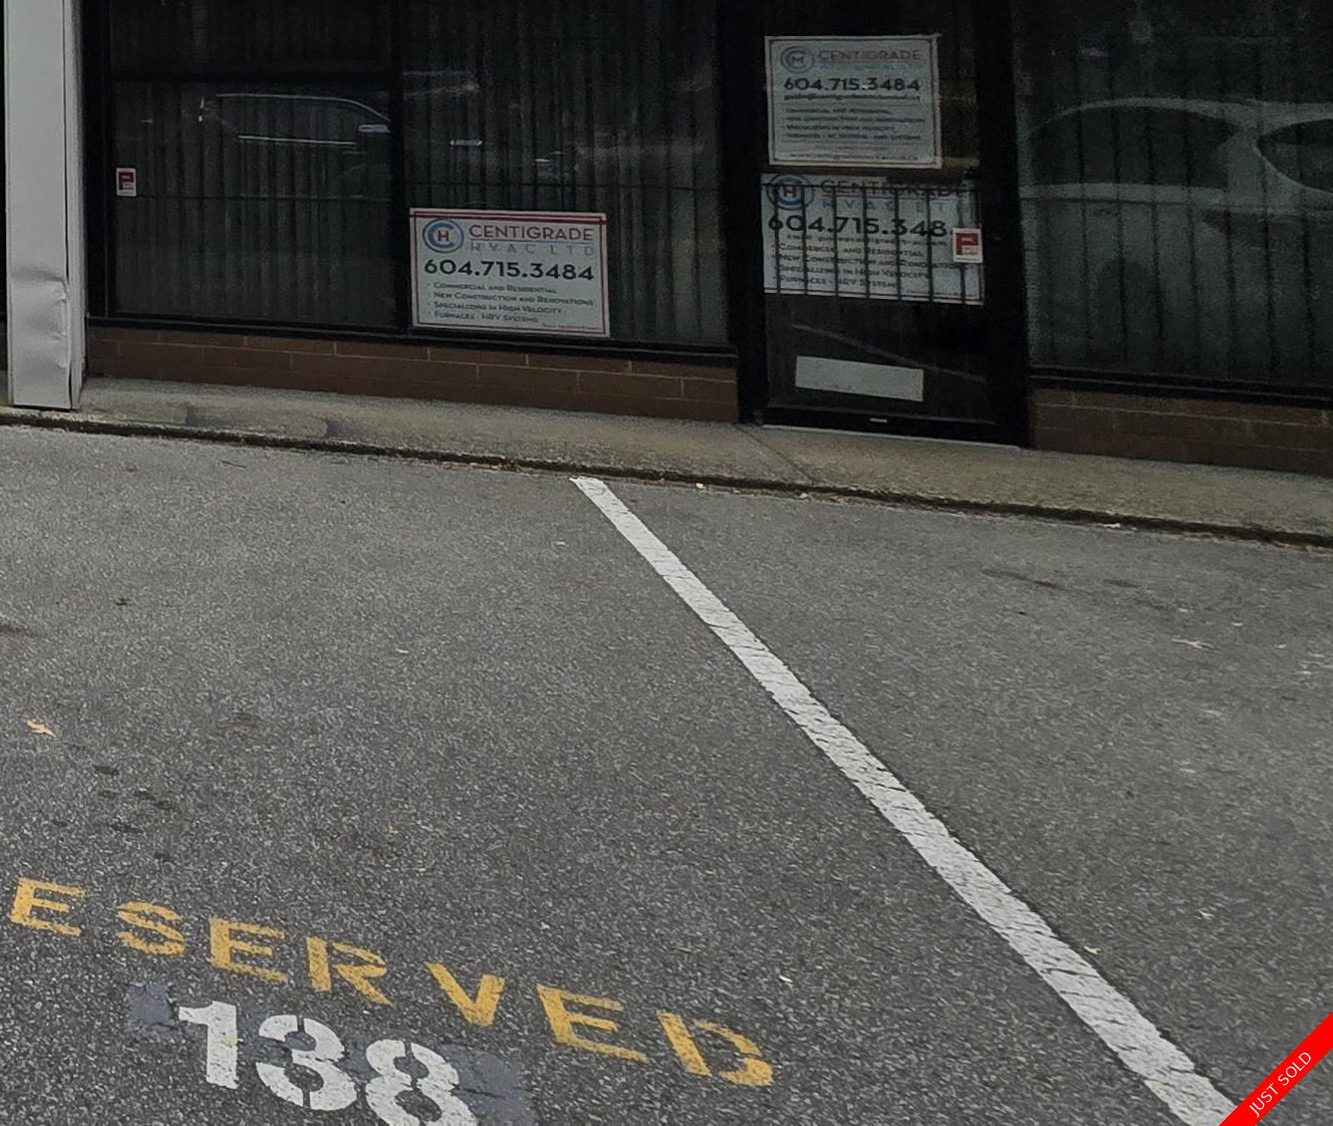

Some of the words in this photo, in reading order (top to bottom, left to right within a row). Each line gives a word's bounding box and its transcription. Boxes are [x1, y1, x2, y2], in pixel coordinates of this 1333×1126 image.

[784, 77, 921, 91] 604.715.3484
[469, 225, 594, 241] CENTIGRADE
[470, 243, 535, 254] HVAC
[550, 245, 595, 256] LTD
[424, 259, 594, 281] 604.715.3484
[177, 1000, 478, 1126] 138
